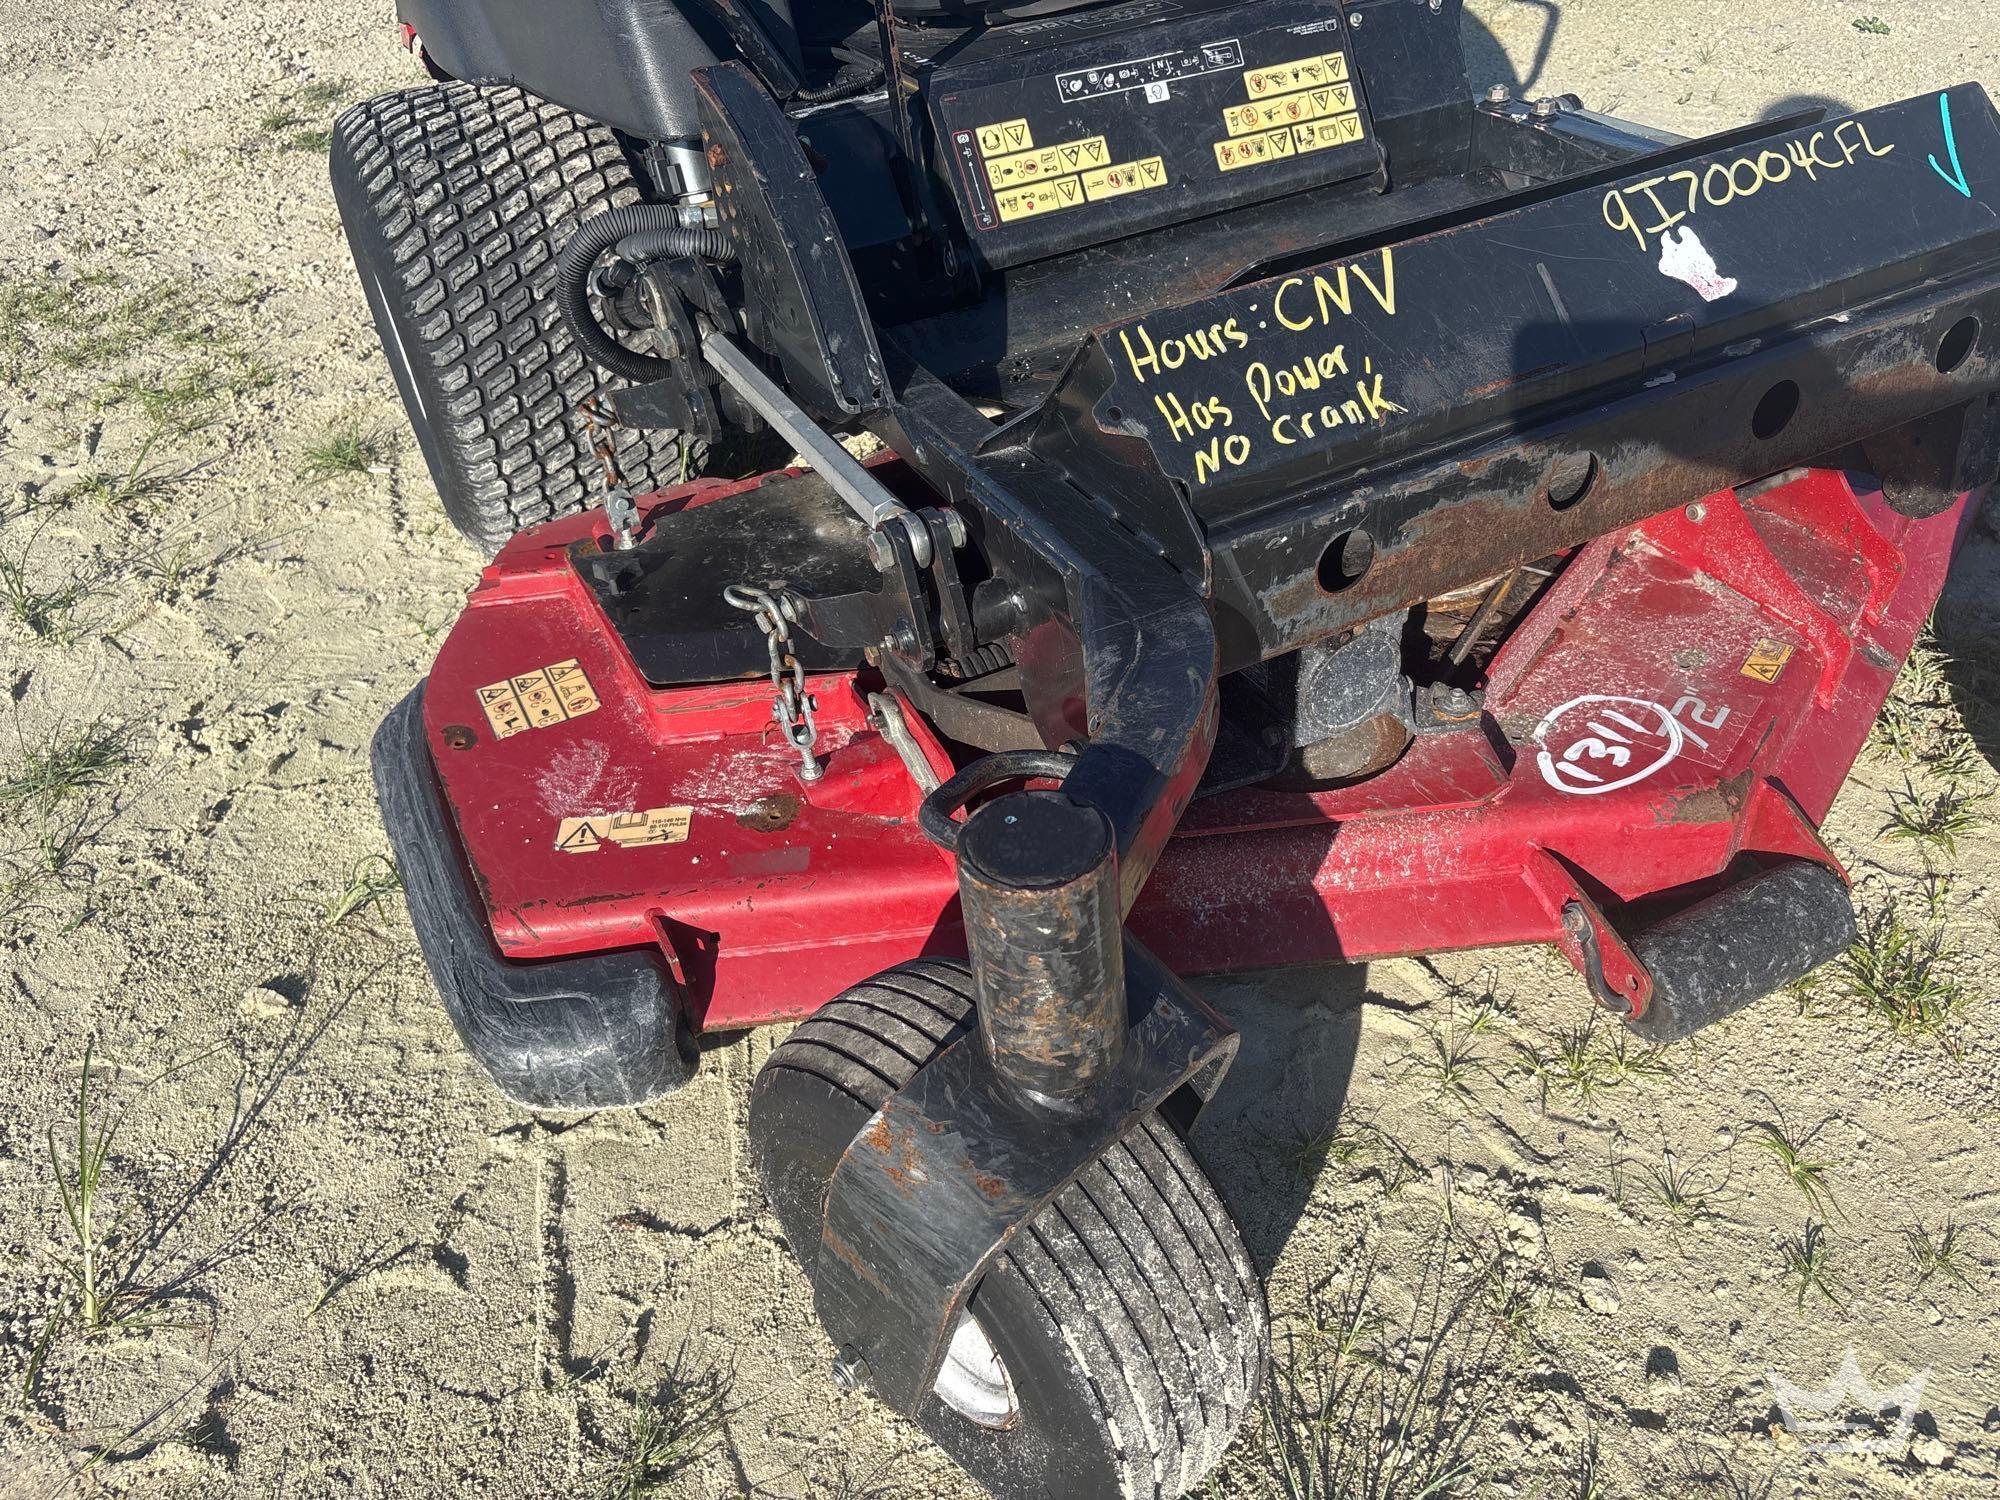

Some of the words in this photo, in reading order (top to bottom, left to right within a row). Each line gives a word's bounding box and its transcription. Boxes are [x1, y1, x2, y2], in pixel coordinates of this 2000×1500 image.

[1119, 304, 1267, 383] Hours:
[1274, 247, 1396, 332] CNV
[1154, 391, 1234, 443] Has
